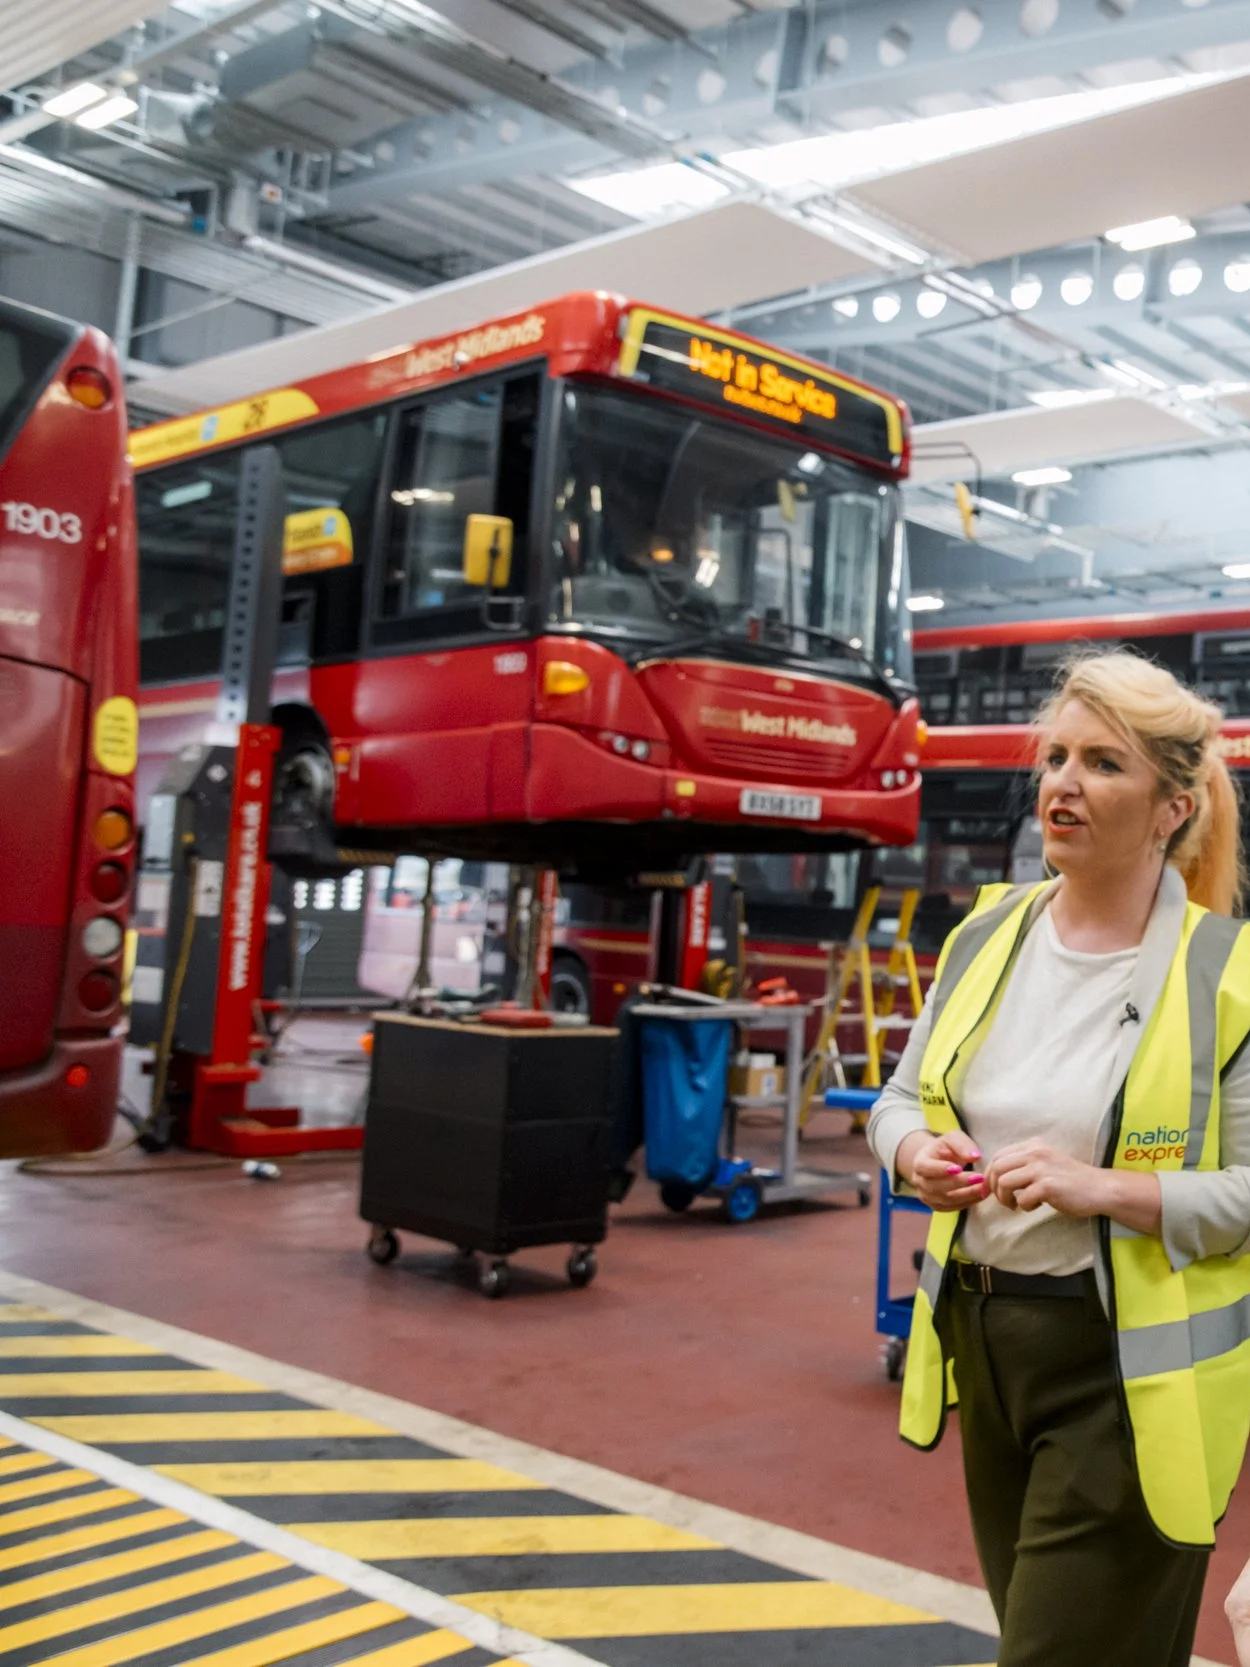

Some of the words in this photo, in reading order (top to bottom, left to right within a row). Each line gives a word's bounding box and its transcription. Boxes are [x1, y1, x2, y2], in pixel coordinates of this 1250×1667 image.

[689, 336, 734, 382] Not
[735, 354, 758, 391] in
[759, 363, 836, 419] Service
[1, 501, 82, 544] 1903
[739, 709, 785, 737] West
[786, 716, 857, 746] Midlands
[1124, 1145, 1187, 1165] expre
